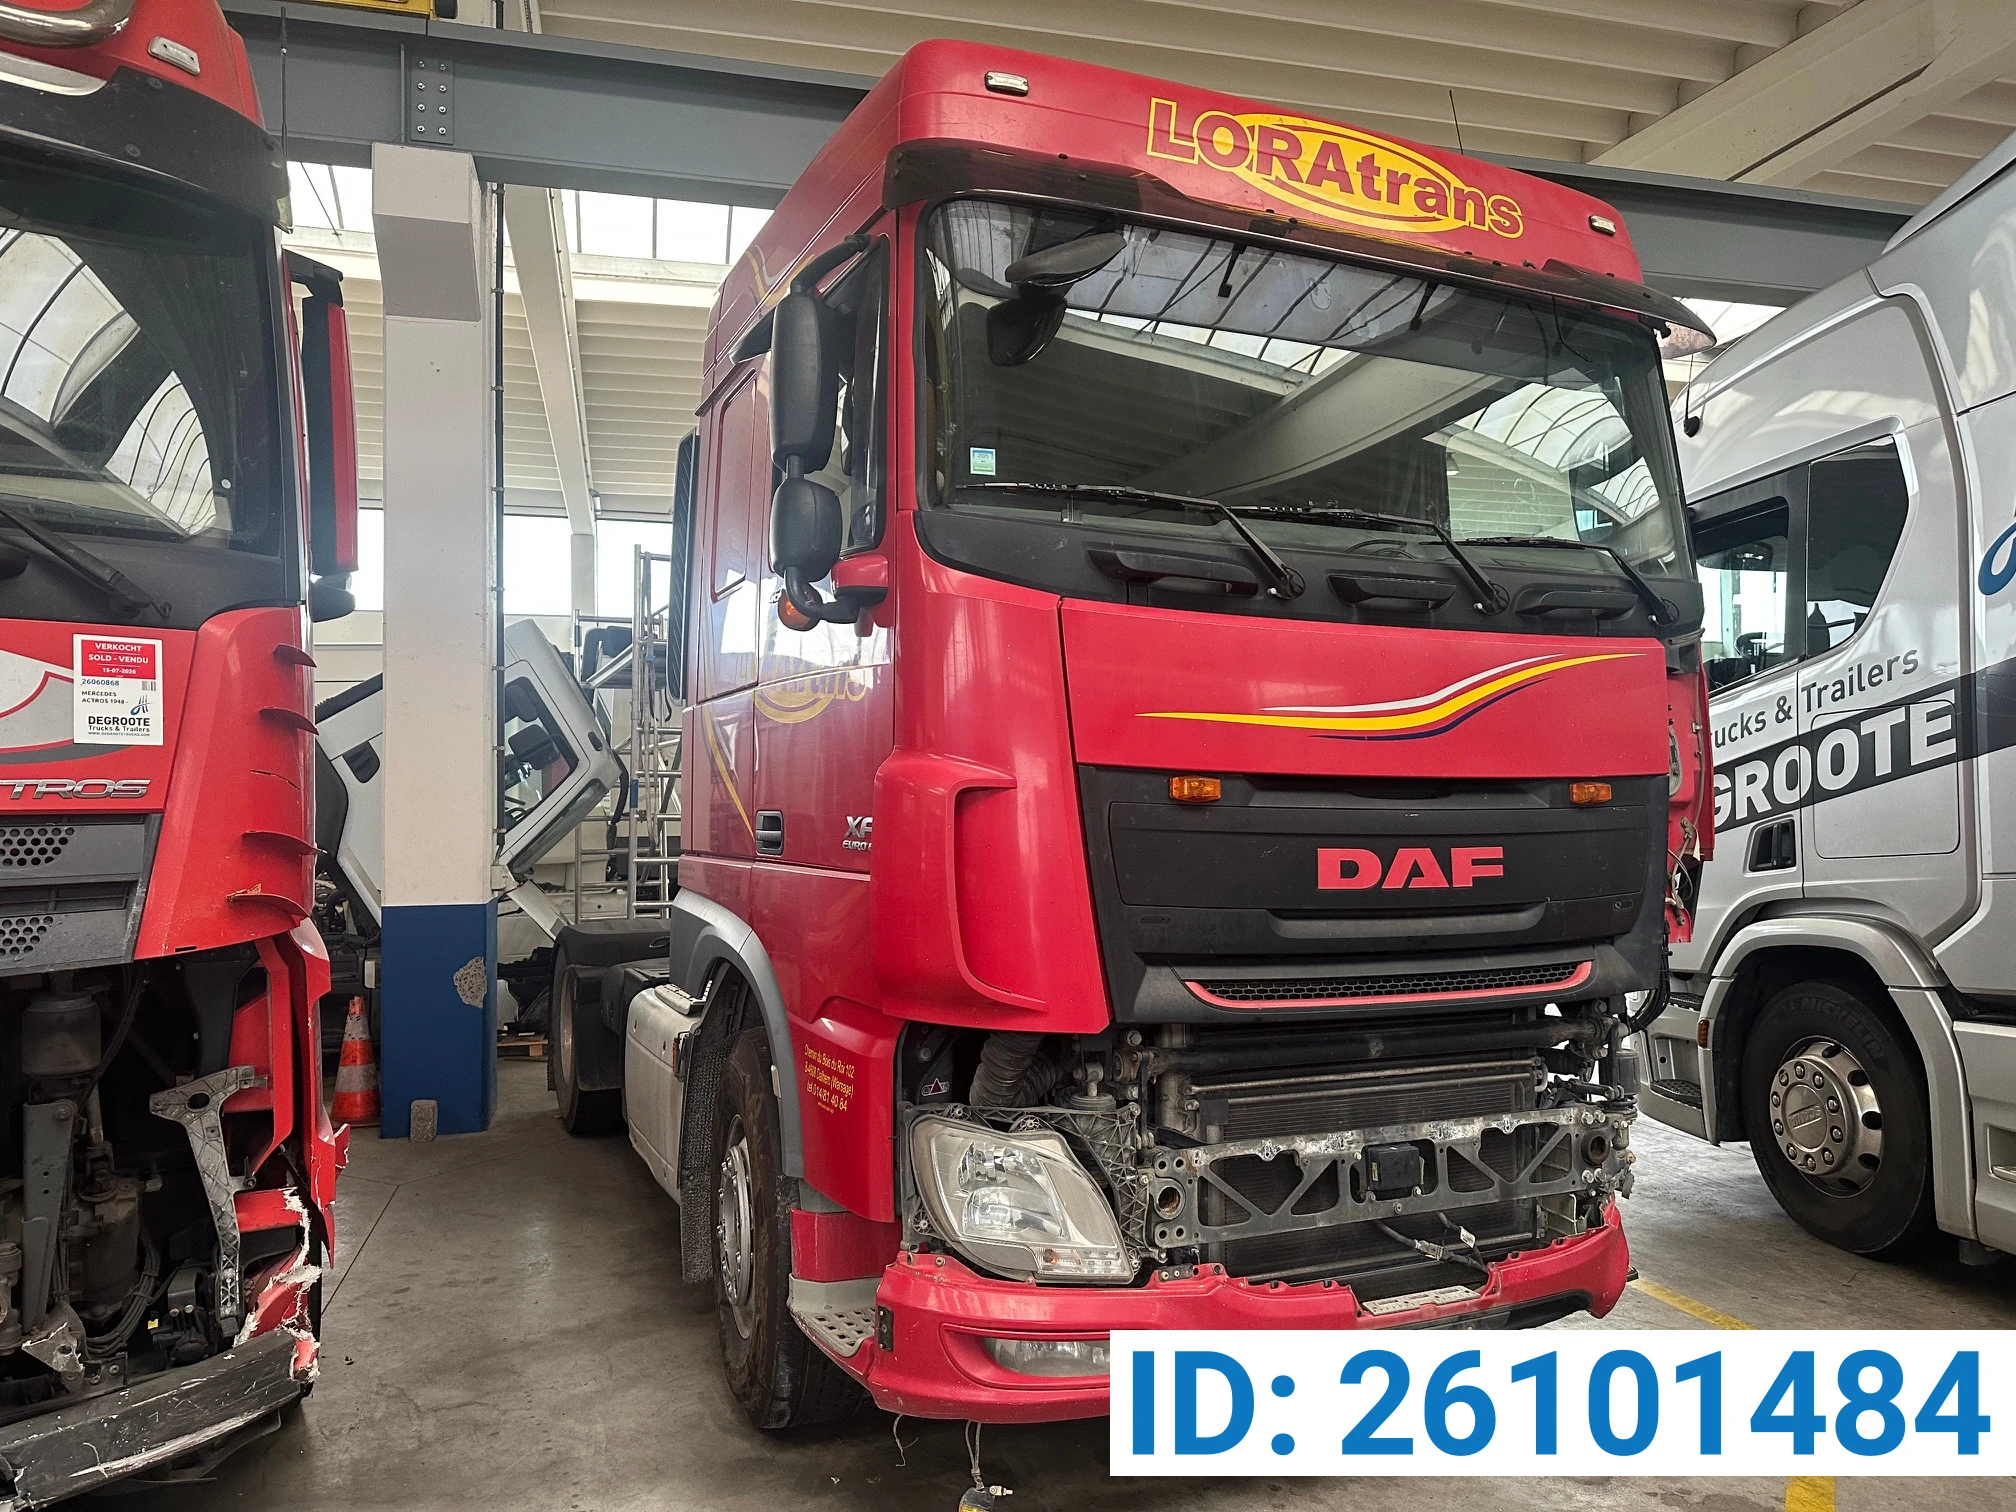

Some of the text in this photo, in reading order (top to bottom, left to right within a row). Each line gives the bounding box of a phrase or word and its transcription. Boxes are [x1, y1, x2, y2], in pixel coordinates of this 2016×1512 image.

[1146, 97, 1524, 239] LORAtrans
[95, 642, 142, 652] VERKOCHT
[88, 653, 112, 662] SOLD
[118, 655, 149, 664] VENDU
[102, 667, 137, 675] 15-07-2026
[82, 678, 120, 686] 26060868
[1710, 649, 1919, 748] ucks & Trailers
[88, 716, 150, 726] DEGROOTE
[122, 725, 150, 733] Trailers
[1713, 689, 1957, 828] GROOTE
[0, 778, 151, 799] TROS
[844, 816, 873, 839] XF
[842, 839, 868, 851] EURO
[1317, 846, 1504, 890] DAF
[1799, 996, 1885, 1061] MICHELIN
[822, 1052, 831, 1068] Bois
[831, 1058, 837, 1071] du
[837, 1060, 846, 1075] Roi
[830, 1094, 839, 1108] 40
[839, 1097, 848, 1112] 84
